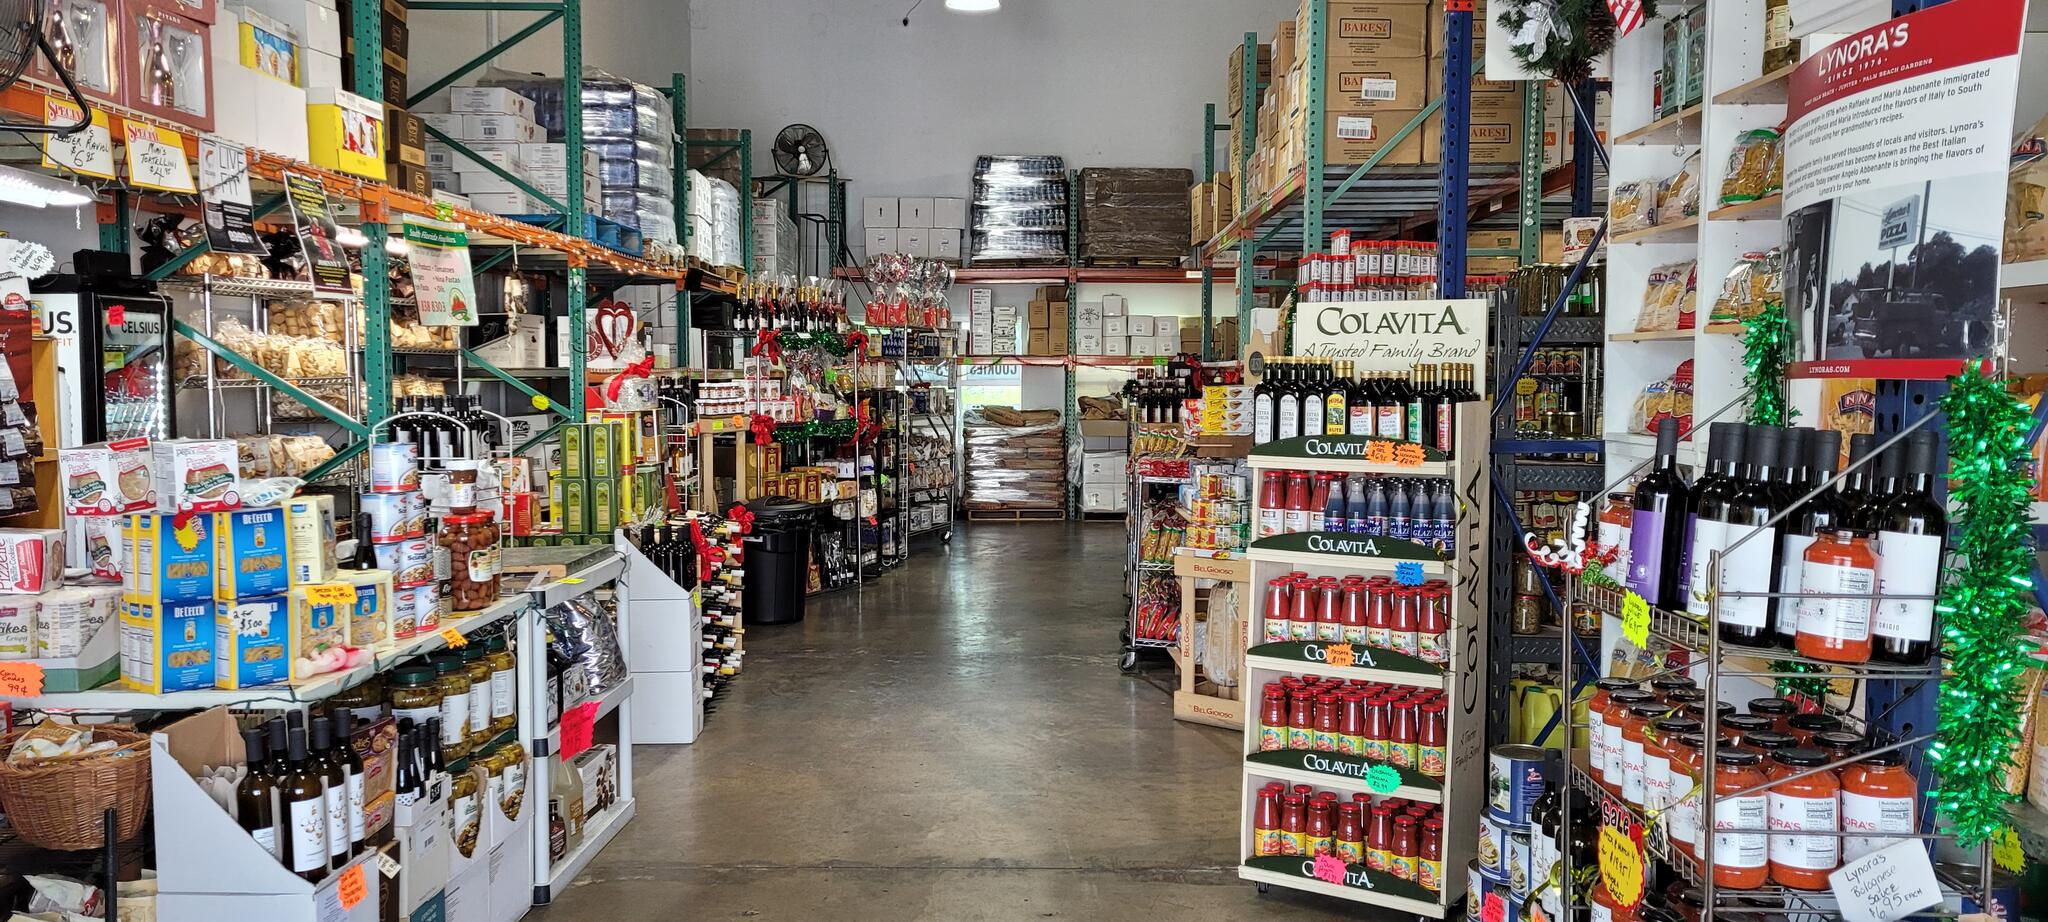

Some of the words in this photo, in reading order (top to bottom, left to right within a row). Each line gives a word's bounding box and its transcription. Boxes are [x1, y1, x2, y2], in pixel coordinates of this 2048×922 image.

[1344, 23, 1387, 32] BARESI
[1818, 22, 1910, 77] LYNORA'S
[1828, 67, 1853, 83] SINCE
[1859, 58, 1882, 71] 1976
[1863, 73, 1878, 82] PALM
[1879, 66, 1899, 77] BEACH
[1900, 57, 1933, 71] GARDENS
[1871, 93, 1883, 103] and
[1883, 89, 1901, 101] Maria
[1902, 79, 1942, 95] Abbenante
[1943, 67, 1990, 85] immigrated
[1852, 105, 1881, 121] introduced
[1882, 101, 1894, 112] the
[1894, 97, 1918, 109] flavors
[1919, 93, 1927, 103] of
[1928, 88, 1946, 101] Italy
[1947, 86, 1956, 97] to
[1957, 82, 1983, 95] South
[1879, 112, 1905, 127] recipes.
[1471, 129, 1507, 138] ARESI
[1847, 141, 1875, 155] thousands
[1876, 138, 1883, 148] of
[1883, 135, 1902, 147] locals
[1903, 131, 1917, 142] and
[1918, 127, 1948, 139] visitors.
[1949, 119, 1985, 134] Lynora's
[1841, 168, 1859, 180] Angelo
[1859, 161, 1891, 175] Abbenante
[1892, 159, 1899, 168] is
[1900, 153, 1929, 167] bringing
[1930, 150, 1944, 161] the
[1945, 147, 1973, 159] flavors
[1975, 144, 1985, 154] of
[1845, 158, 1854, 168] has
[1854, 153, 1877, 166] become
[1877, 148, 1898, 160] known
[1899, 147, 1908, 155] as
[1909, 142, 1921, 153] the
[1922, 140, 1940, 151] Best
[1941, 136, 1967, 147] Italian
[1842, 180, 1854, 191] your
[1880, 221, 1907, 240] PIZZA
[121, 320, 160, 334] CELSIUS
[1316, 304, 1467, 336] COLAVITA
[1301, 342, 1317, 358] A
[1319, 340, 1370, 359] Trusted
[1371, 339, 1424, 368] Family
[1427, 339, 1481, 359] Brand
[1809, 365, 1850, 374] LYNORAS.COM
[1308, 535, 1379, 555] COLAVITA
[1463, 465, 1482, 714] COLAVITA
[1304, 645, 1377, 667] COTA
[1770, 816, 1801, 830] ORA'S
[1845, 815, 1876, 829] ORA'S
[1845, 854, 1887, 884] Lynora's
[1850, 865, 1897, 898] Bolognese
